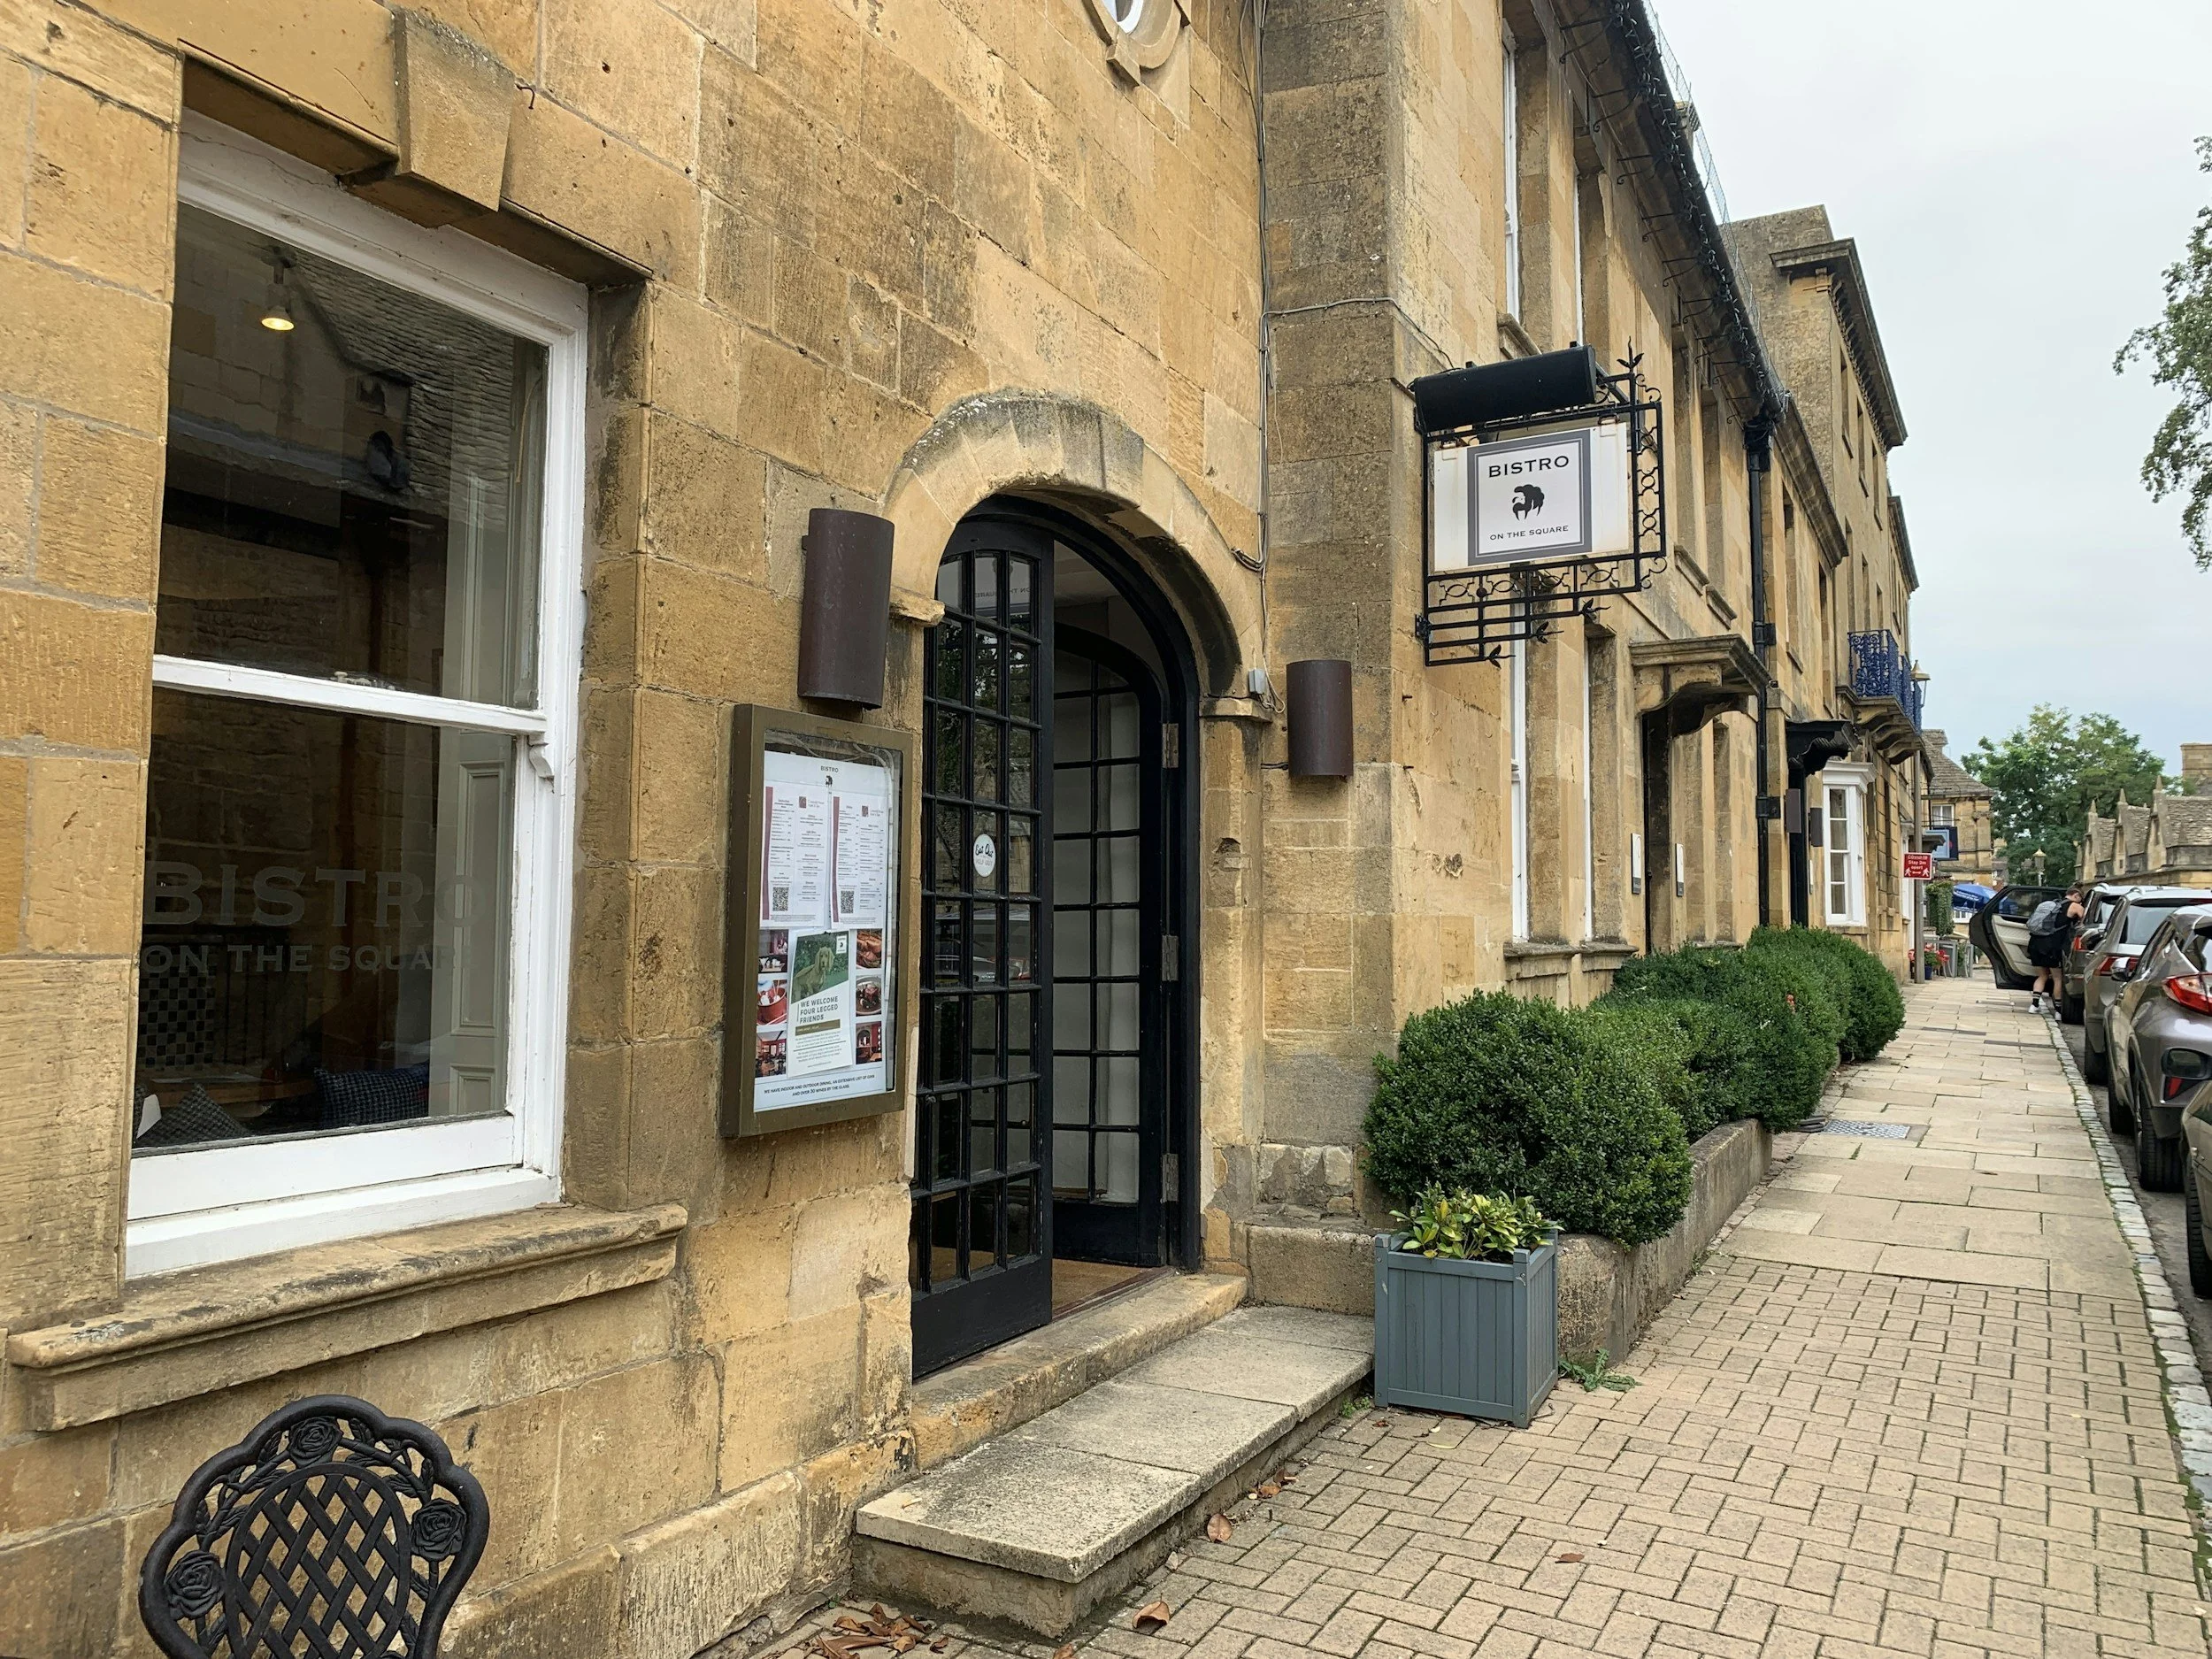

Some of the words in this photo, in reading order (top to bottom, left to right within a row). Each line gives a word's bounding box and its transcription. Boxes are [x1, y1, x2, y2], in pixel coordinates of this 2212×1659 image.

[1488, 456, 1569, 478] BISTRO
[1529, 526, 1569, 536] SQUARE
[975, 844, 984, 856] Eat
[985, 843, 994, 858] Out
[144, 859, 487, 927] BISTRO
[142, 945, 210, 973] ON
[227, 945, 313, 972] THE
[810, 996, 839, 1006] WELCOME
[817, 1003, 839, 1013] LEGGED
[800, 1015, 824, 1024] FRIENDS
